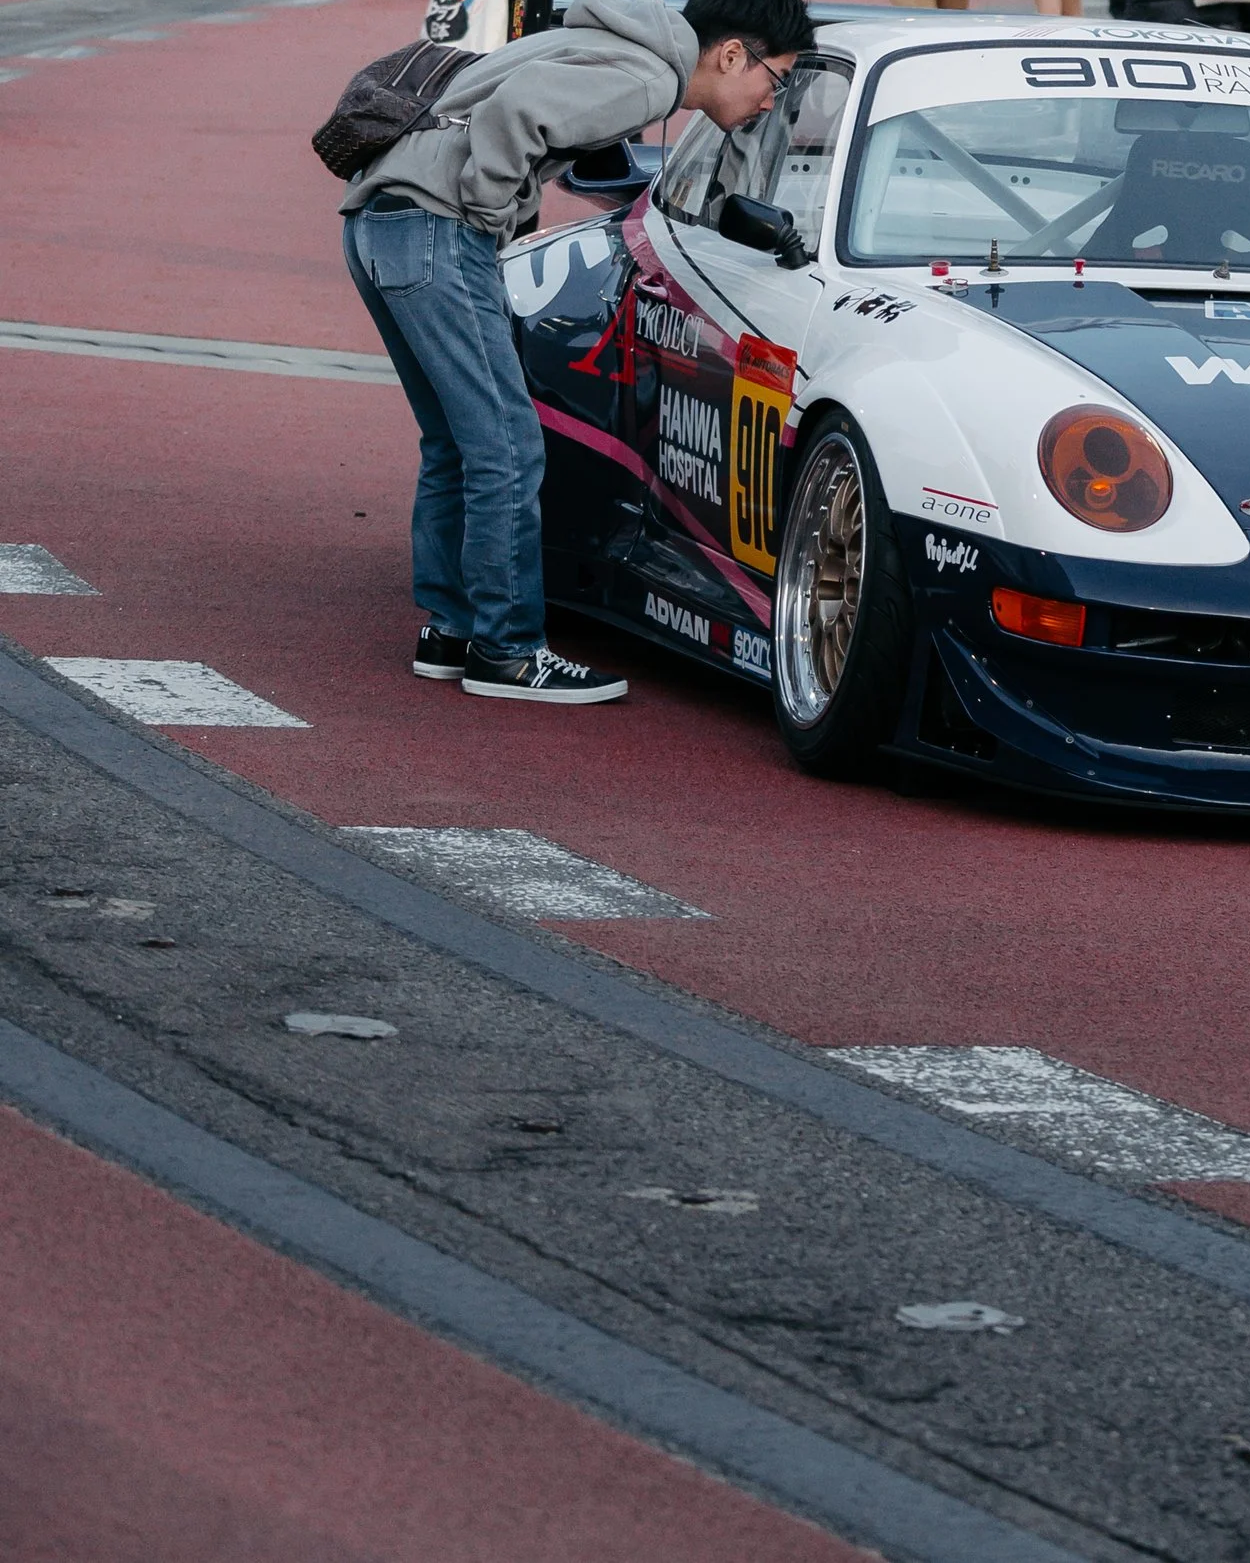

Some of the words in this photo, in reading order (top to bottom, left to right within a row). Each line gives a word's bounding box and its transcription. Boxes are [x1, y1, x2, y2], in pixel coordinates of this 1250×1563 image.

[1021, 56, 1196, 91] 910
[1152, 159, 1246, 182] RECARO
[636, 299, 706, 359] PROJECT
[659, 384, 722, 463] HANWA
[659, 440, 722, 506] HOSPITAL
[736, 395, 781, 557] 910
[921, 496, 991, 524] a-one
[644, 591, 710, 646] ADVAN
